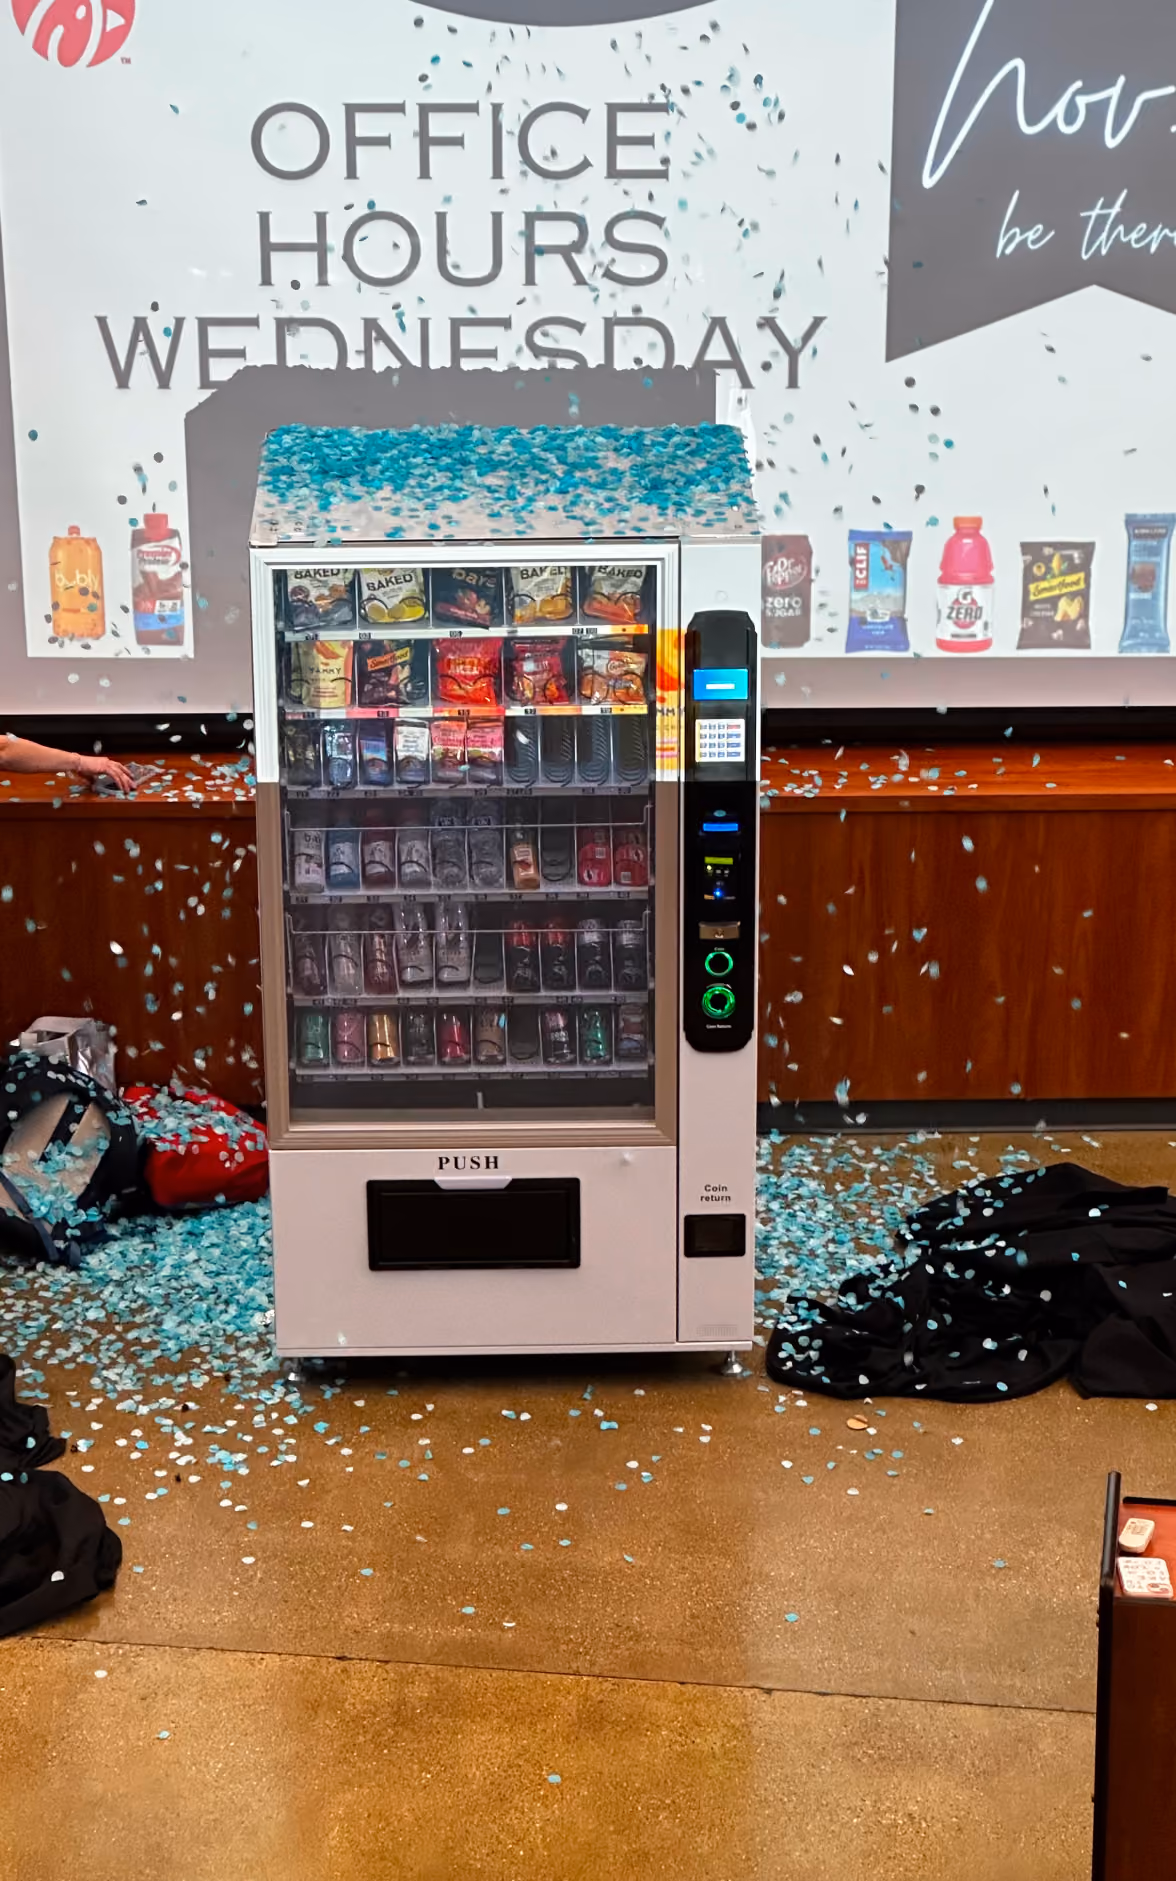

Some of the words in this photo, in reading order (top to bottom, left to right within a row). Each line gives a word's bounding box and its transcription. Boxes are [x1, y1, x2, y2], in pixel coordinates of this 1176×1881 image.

[251, 101, 670, 181] OFFICE
[995, 190, 1055, 259] be
[257, 209, 668, 287] HOURS
[95, 315, 828, 390] WEDNESDAY
[855, 546, 868, 578] CLIF
[366, 573, 413, 592] BAKED
[946, 605, 984, 621] ZERO
[438, 1155, 499, 1171] PUSH
[704, 1184, 728, 1193] Coin
